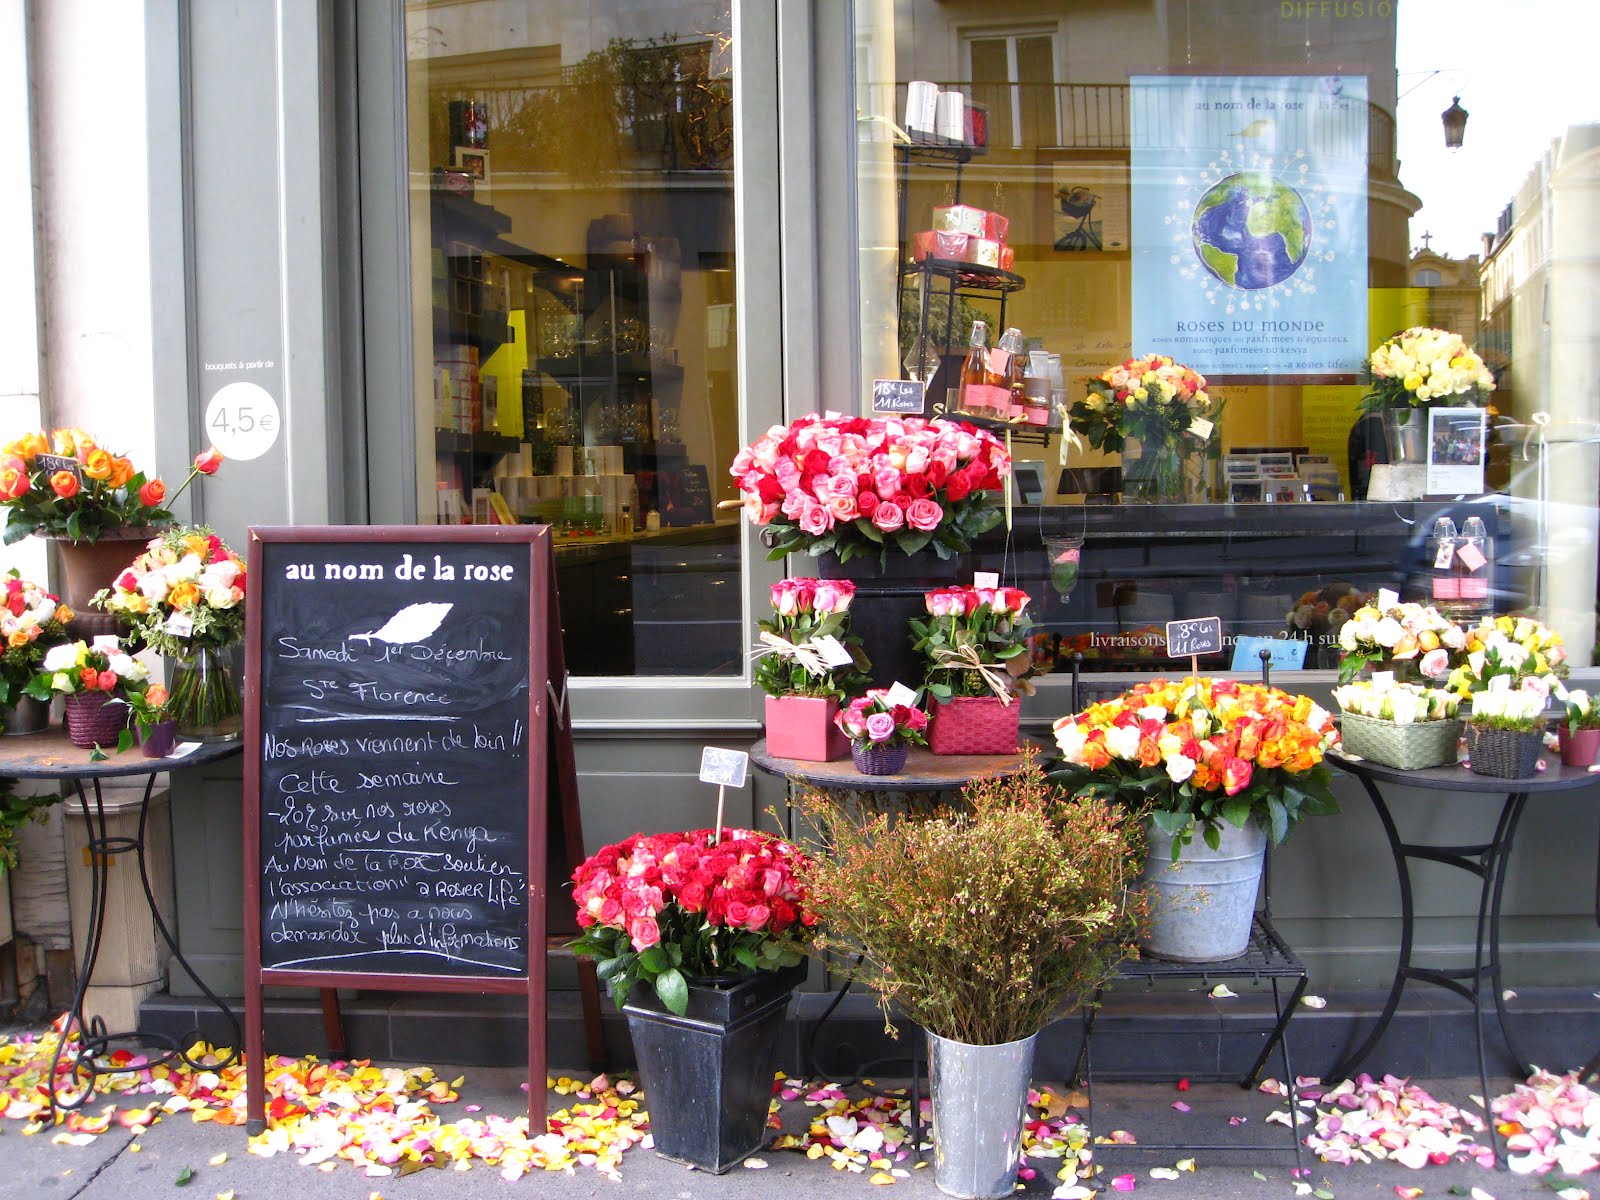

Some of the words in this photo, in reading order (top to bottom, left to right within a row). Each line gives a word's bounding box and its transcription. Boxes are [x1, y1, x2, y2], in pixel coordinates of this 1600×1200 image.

[1214, 101, 1242, 110] nom
[1247, 97, 1261, 110] de
[1265, 98, 1275, 110] la
[1232, 320, 1254, 332] DU
[205, 362, 237, 371] bouquets
[238, 360, 244, 369] à
[246, 361, 264, 370] partir
[265, 360, 274, 368] de
[285, 563, 315, 581] au
[324, 563, 384, 581] nom
[394, 553, 426, 581] de
[433, 554, 455, 581] la
[463, 563, 514, 581] rose
[1091, 631, 1165, 648] livraisons
[1303, 630, 1314, 645] h
[278, 636, 359, 663] Samedi
[374, 645, 403, 663] 1er
[348, 681, 451, 705] Florence
[264, 733, 297, 761] Nos
[356, 732, 437, 754] viennent
[441, 729, 469, 752] de
[473, 724, 506, 752] loin
[279, 769, 347, 795] Cette
[356, 762, 460, 790] semaine
[365, 801, 396, 818] nos
[402, 799, 452, 818] roses
[386, 822, 420, 843] du
[264, 855, 288, 875] Au
[333, 854, 355, 870] de
[364, 855, 384, 872] la
[358, 904, 400, 925] pas
[428, 905, 473, 920] nous
[375, 922, 412, 951] plus
